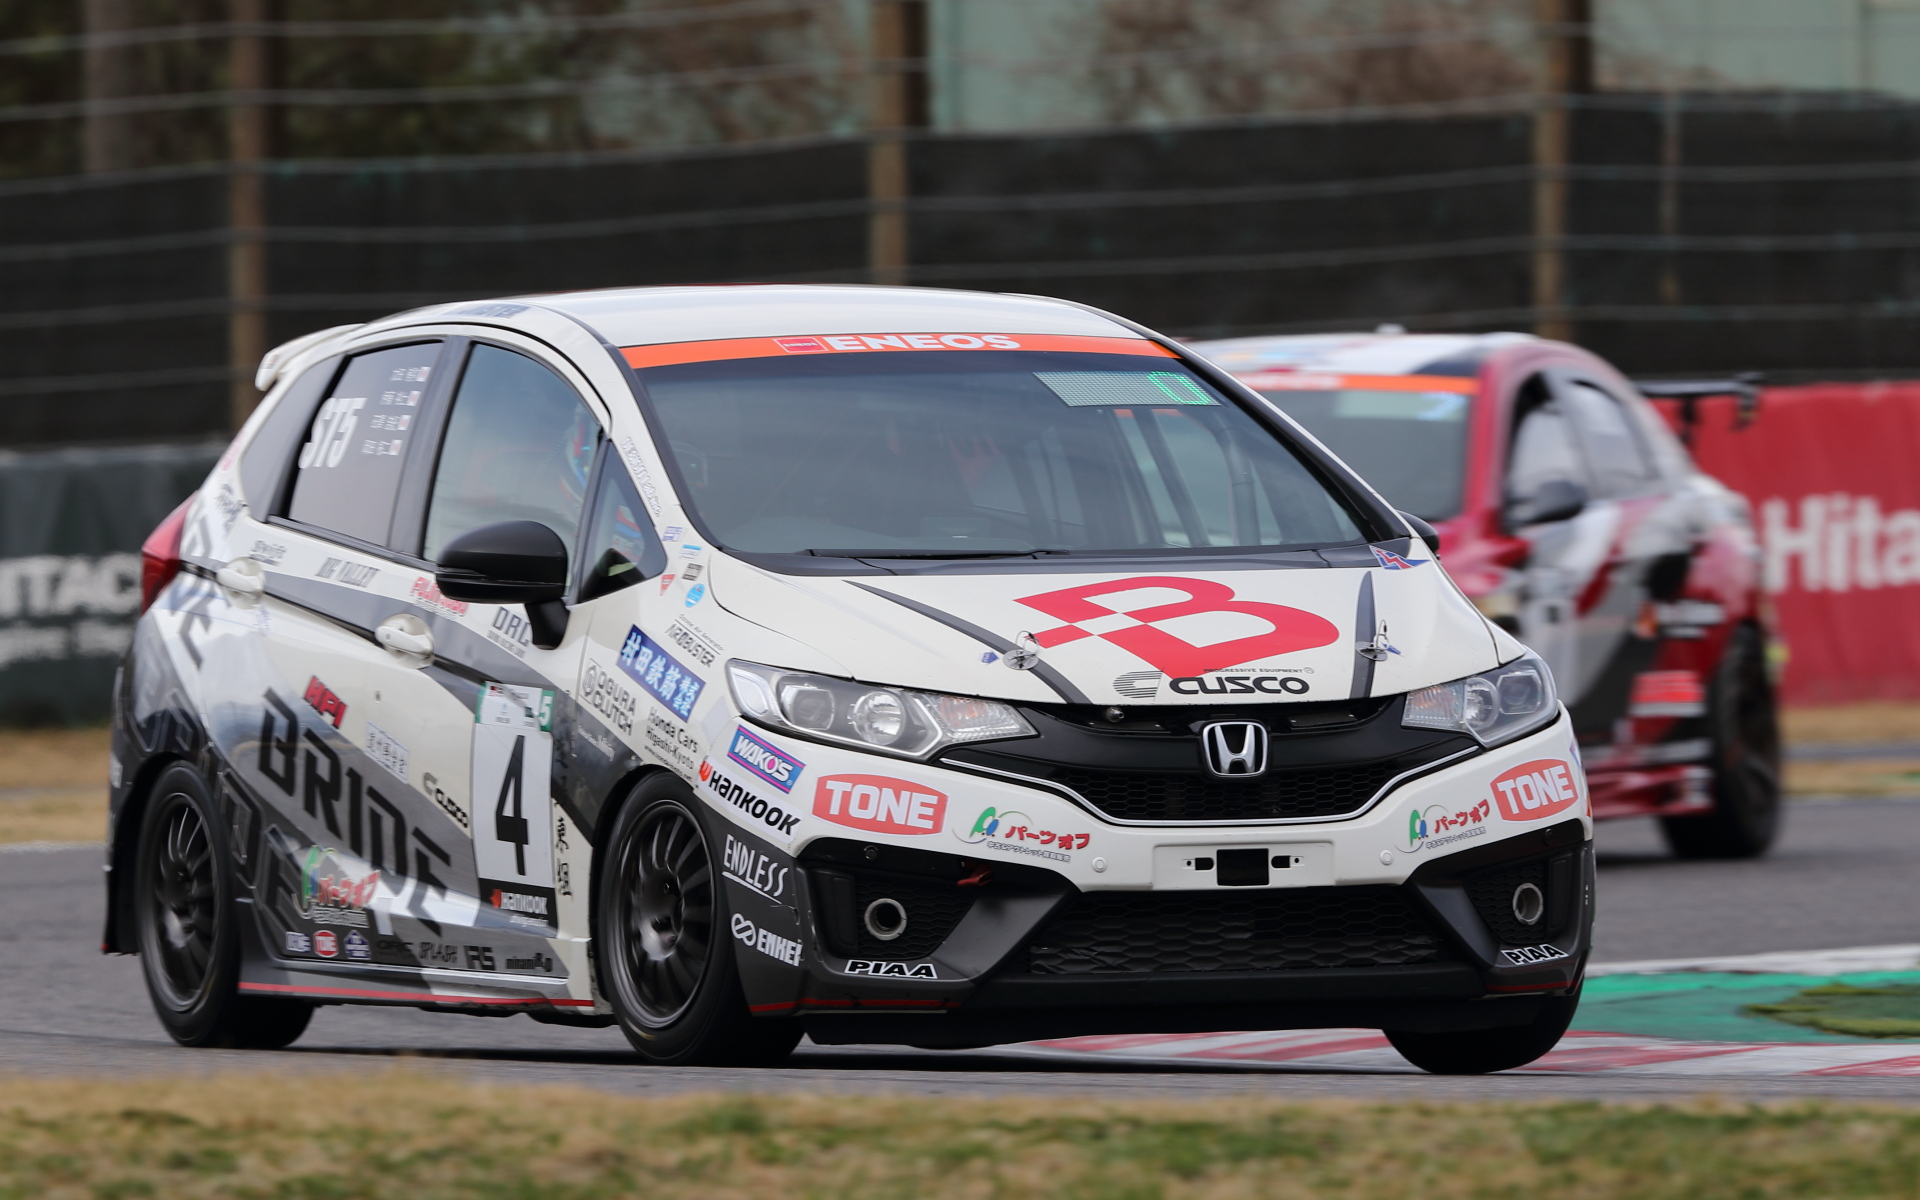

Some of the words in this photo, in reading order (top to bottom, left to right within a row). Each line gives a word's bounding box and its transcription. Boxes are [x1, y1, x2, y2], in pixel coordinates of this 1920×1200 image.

[822, 334, 1021, 350] ENEOS
[298, 397, 368, 469] ST5
[597, 671, 637, 716] OGURA
[1169, 676, 1310, 695] CUSCO
[538, 695, 554, 727] 5
[591, 691, 634, 736] CLUTCH
[647, 706, 677, 738] Honda
[677, 727, 699, 753] Cars
[645, 724, 695, 770] Higashi-Kyoto
[733, 734, 794, 783] WAKO'S
[258, 685, 452, 938] BRIDE
[495, 734, 530, 877] 4
[825, 779, 939, 830] TONE
[1497, 765, 1575, 815] TONE
[1004, 825, 1091, 850] パーツオフ
[1434, 799, 1490, 834] パーツオフ
[723, 834, 789, 897] ENDLESS
[844, 959, 938, 979] PIAA
[1501, 944, 1570, 965] PIAA
